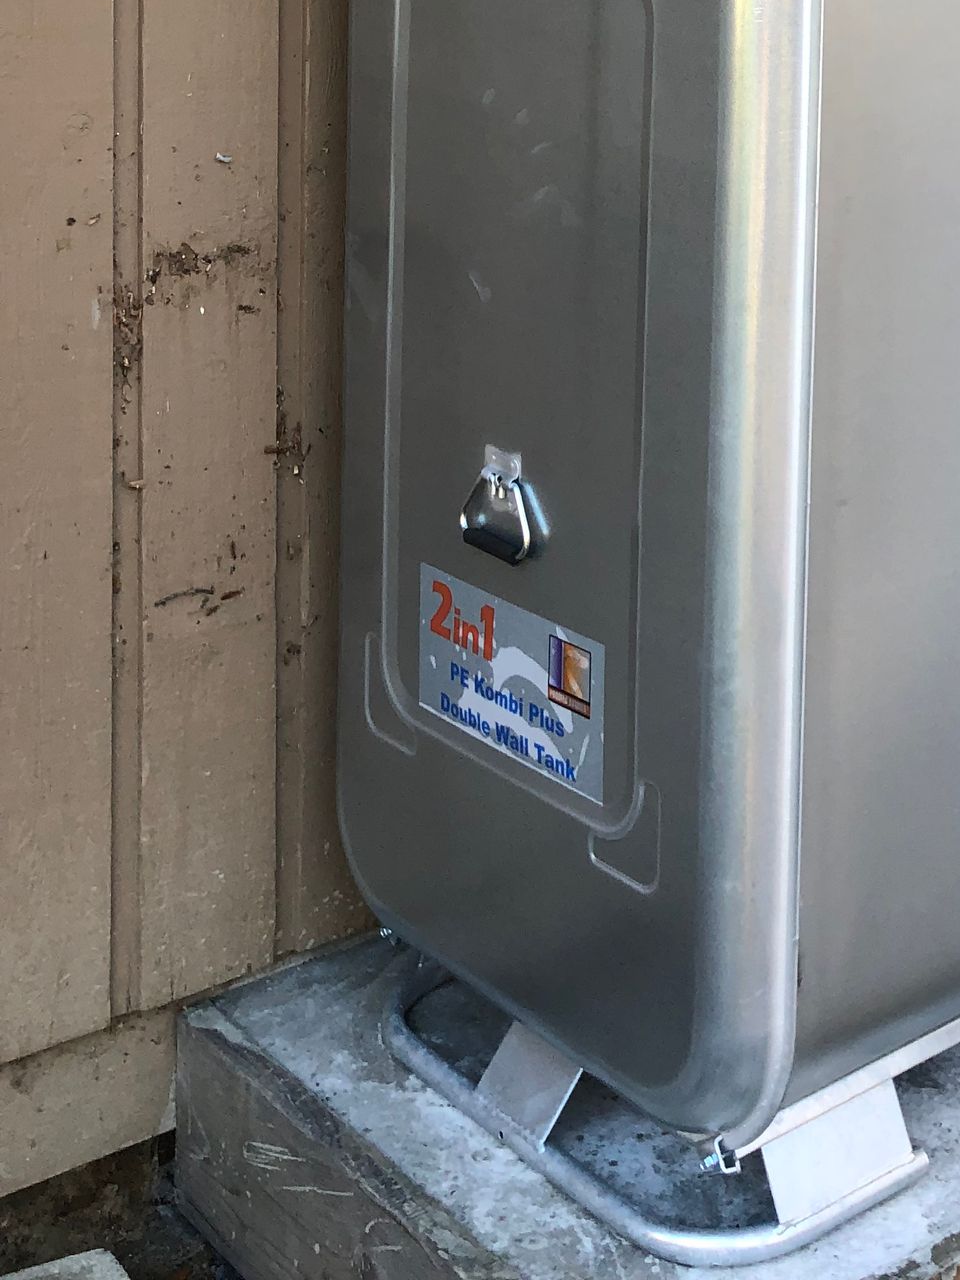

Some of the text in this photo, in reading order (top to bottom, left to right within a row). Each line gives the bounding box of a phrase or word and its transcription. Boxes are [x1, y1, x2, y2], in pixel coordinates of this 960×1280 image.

[429, 580, 496, 662] 2in1
[440, 692, 577, 783] Double Wall Tank
[450, 661, 470, 689] PE
[473, 673, 524, 718] Kombi
[528, 704, 566, 738] Plus
